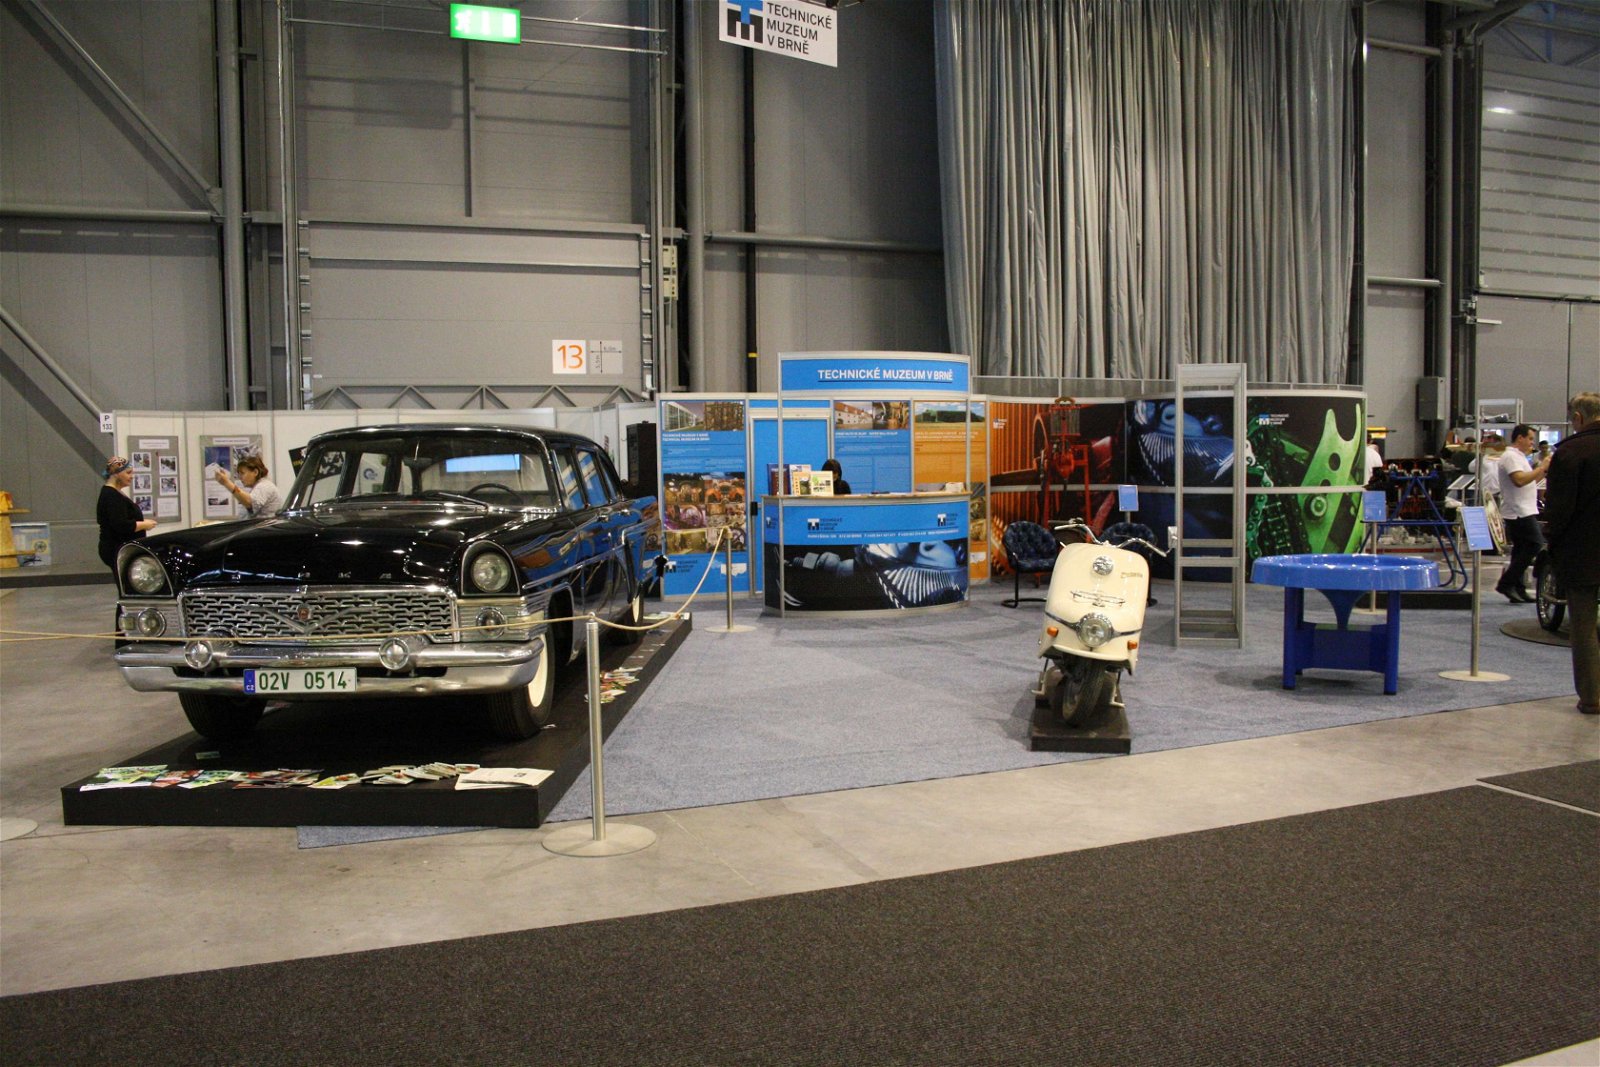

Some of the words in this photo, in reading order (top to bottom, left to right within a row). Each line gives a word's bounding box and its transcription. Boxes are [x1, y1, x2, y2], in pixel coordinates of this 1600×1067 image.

[767, 2, 832, 30] TECHNICKÉ
[767, 18, 818, 41] MUZEUM
[767, 34, 775, 46] V
[777, 36, 809, 55] BRNĚ
[557, 344, 583, 369] 13
[817, 367, 881, 380] TECHNICKÉ
[883, 369, 925, 380] MUZEUM
[926, 370, 933, 380] V
[933, 368, 953, 381] BRNĚ
[102, 423, 113, 431] 133
[104, 414, 110, 422] P
[258, 671, 290, 691] 02V
[304, 671, 347, 690] 0514
